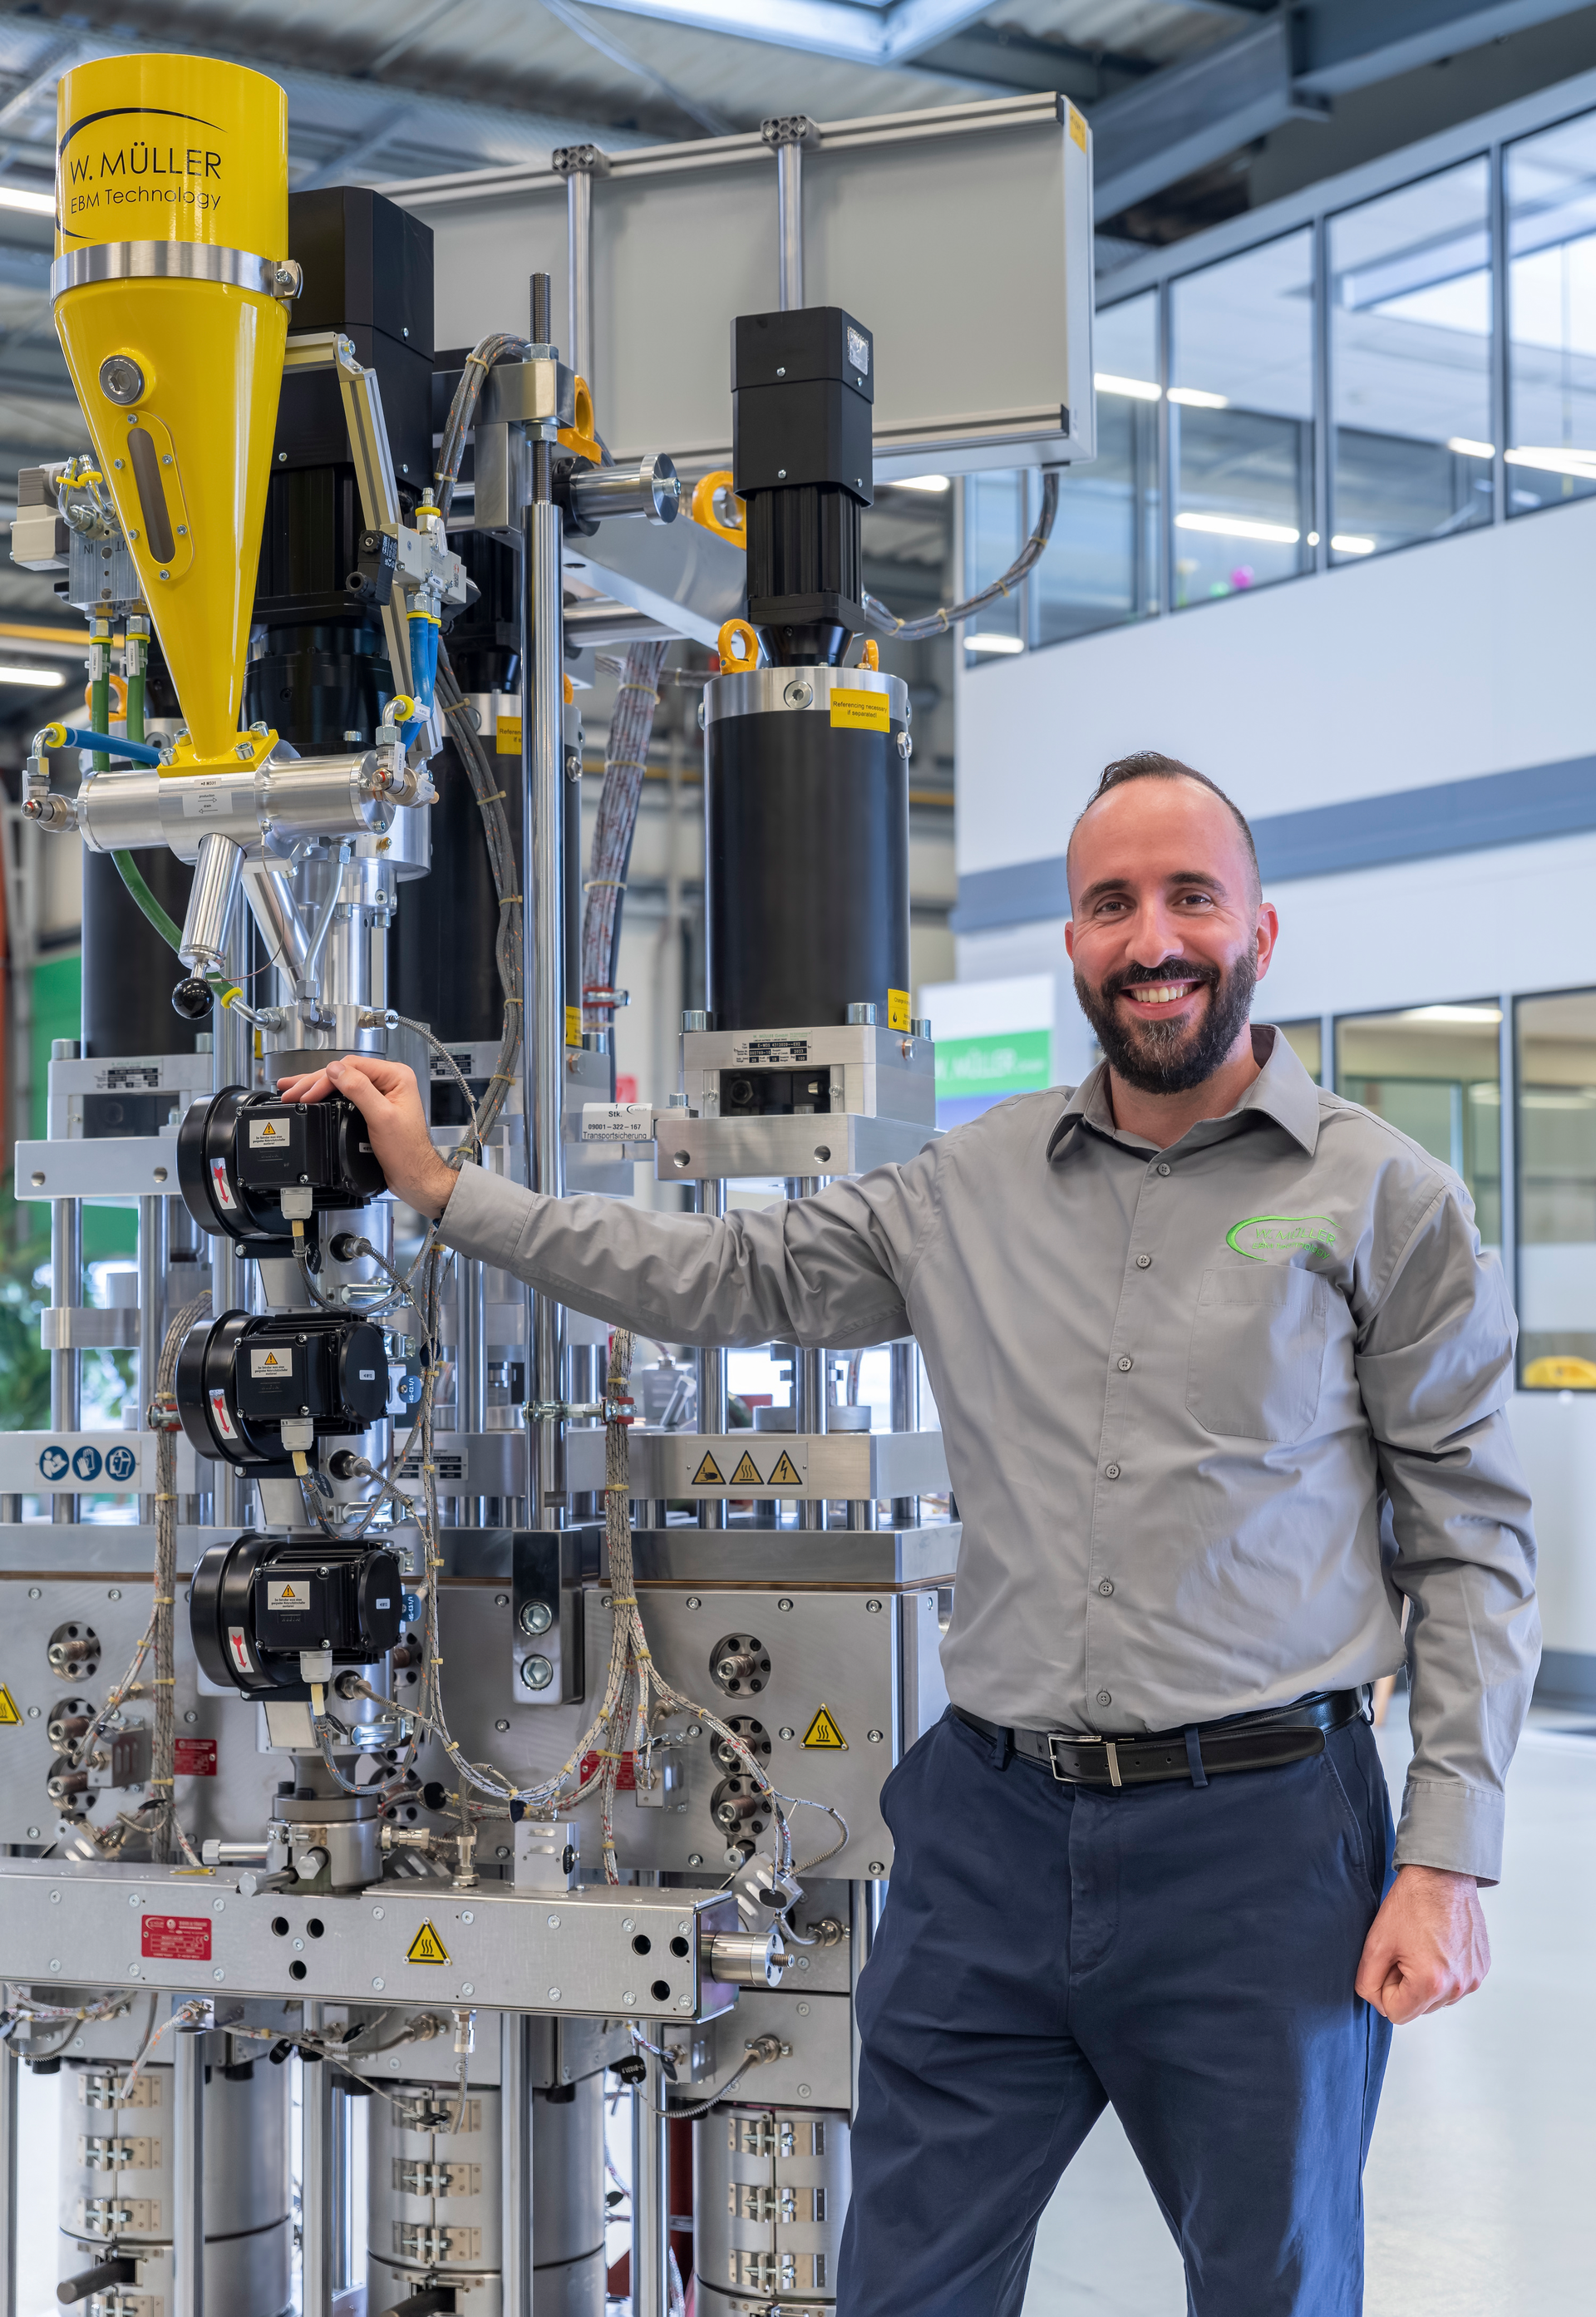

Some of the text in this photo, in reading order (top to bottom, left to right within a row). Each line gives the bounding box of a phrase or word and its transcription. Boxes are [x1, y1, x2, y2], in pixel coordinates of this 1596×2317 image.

[70, 141, 222, 185] W. MÜLLER
[71, 185, 221, 214] EBM Technology
[115, 540, 128, 551] UT
[833, 701, 888, 713] Referencing necessary
[583, 1131, 647, 1140] Transportsicherung
[1256, 1227, 1336, 1247] W. MÜLLER
[1276, 1241, 1330, 1260] Technology
